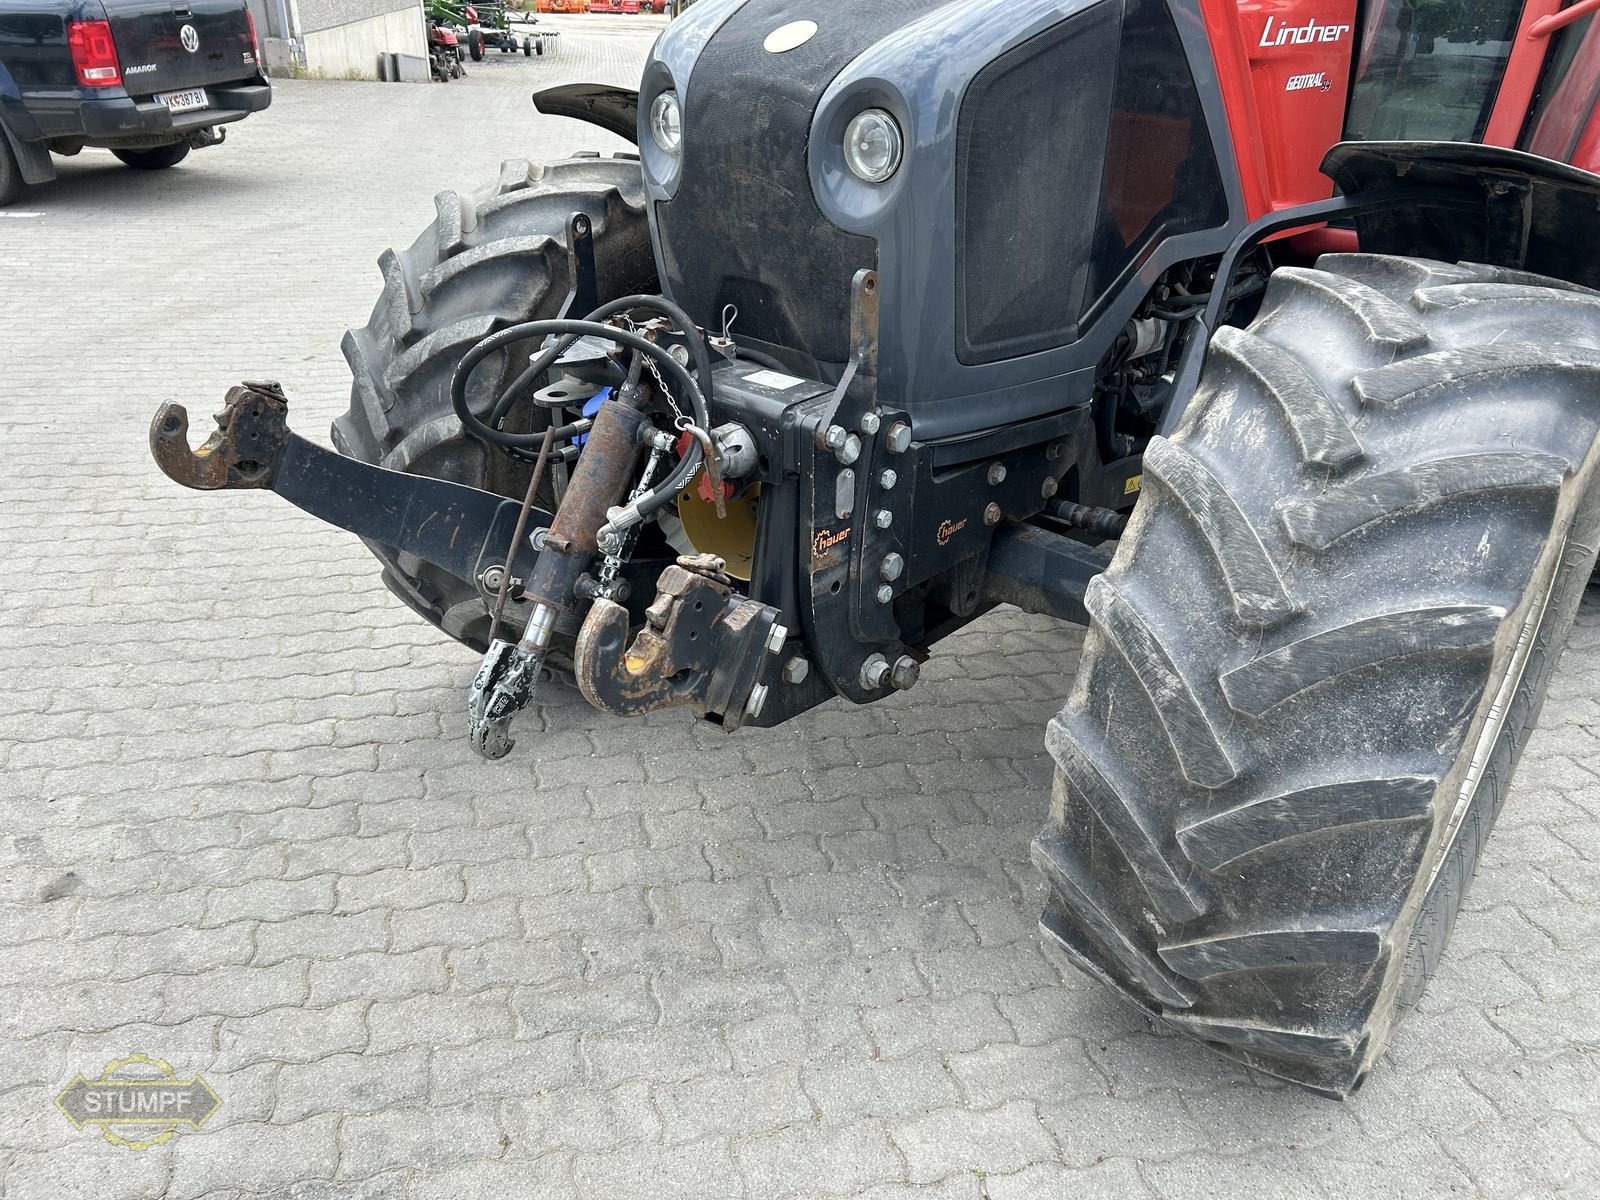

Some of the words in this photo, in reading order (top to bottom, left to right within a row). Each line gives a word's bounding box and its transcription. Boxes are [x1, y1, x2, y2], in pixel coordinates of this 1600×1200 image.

[1259, 16, 1349, 47] Lindner
[125, 63, 157, 75] AMAROK
[1286, 72, 1325, 91] GEOTRAC
[942, 518, 967, 538] hauer
[819, 528, 851, 549] hauer
